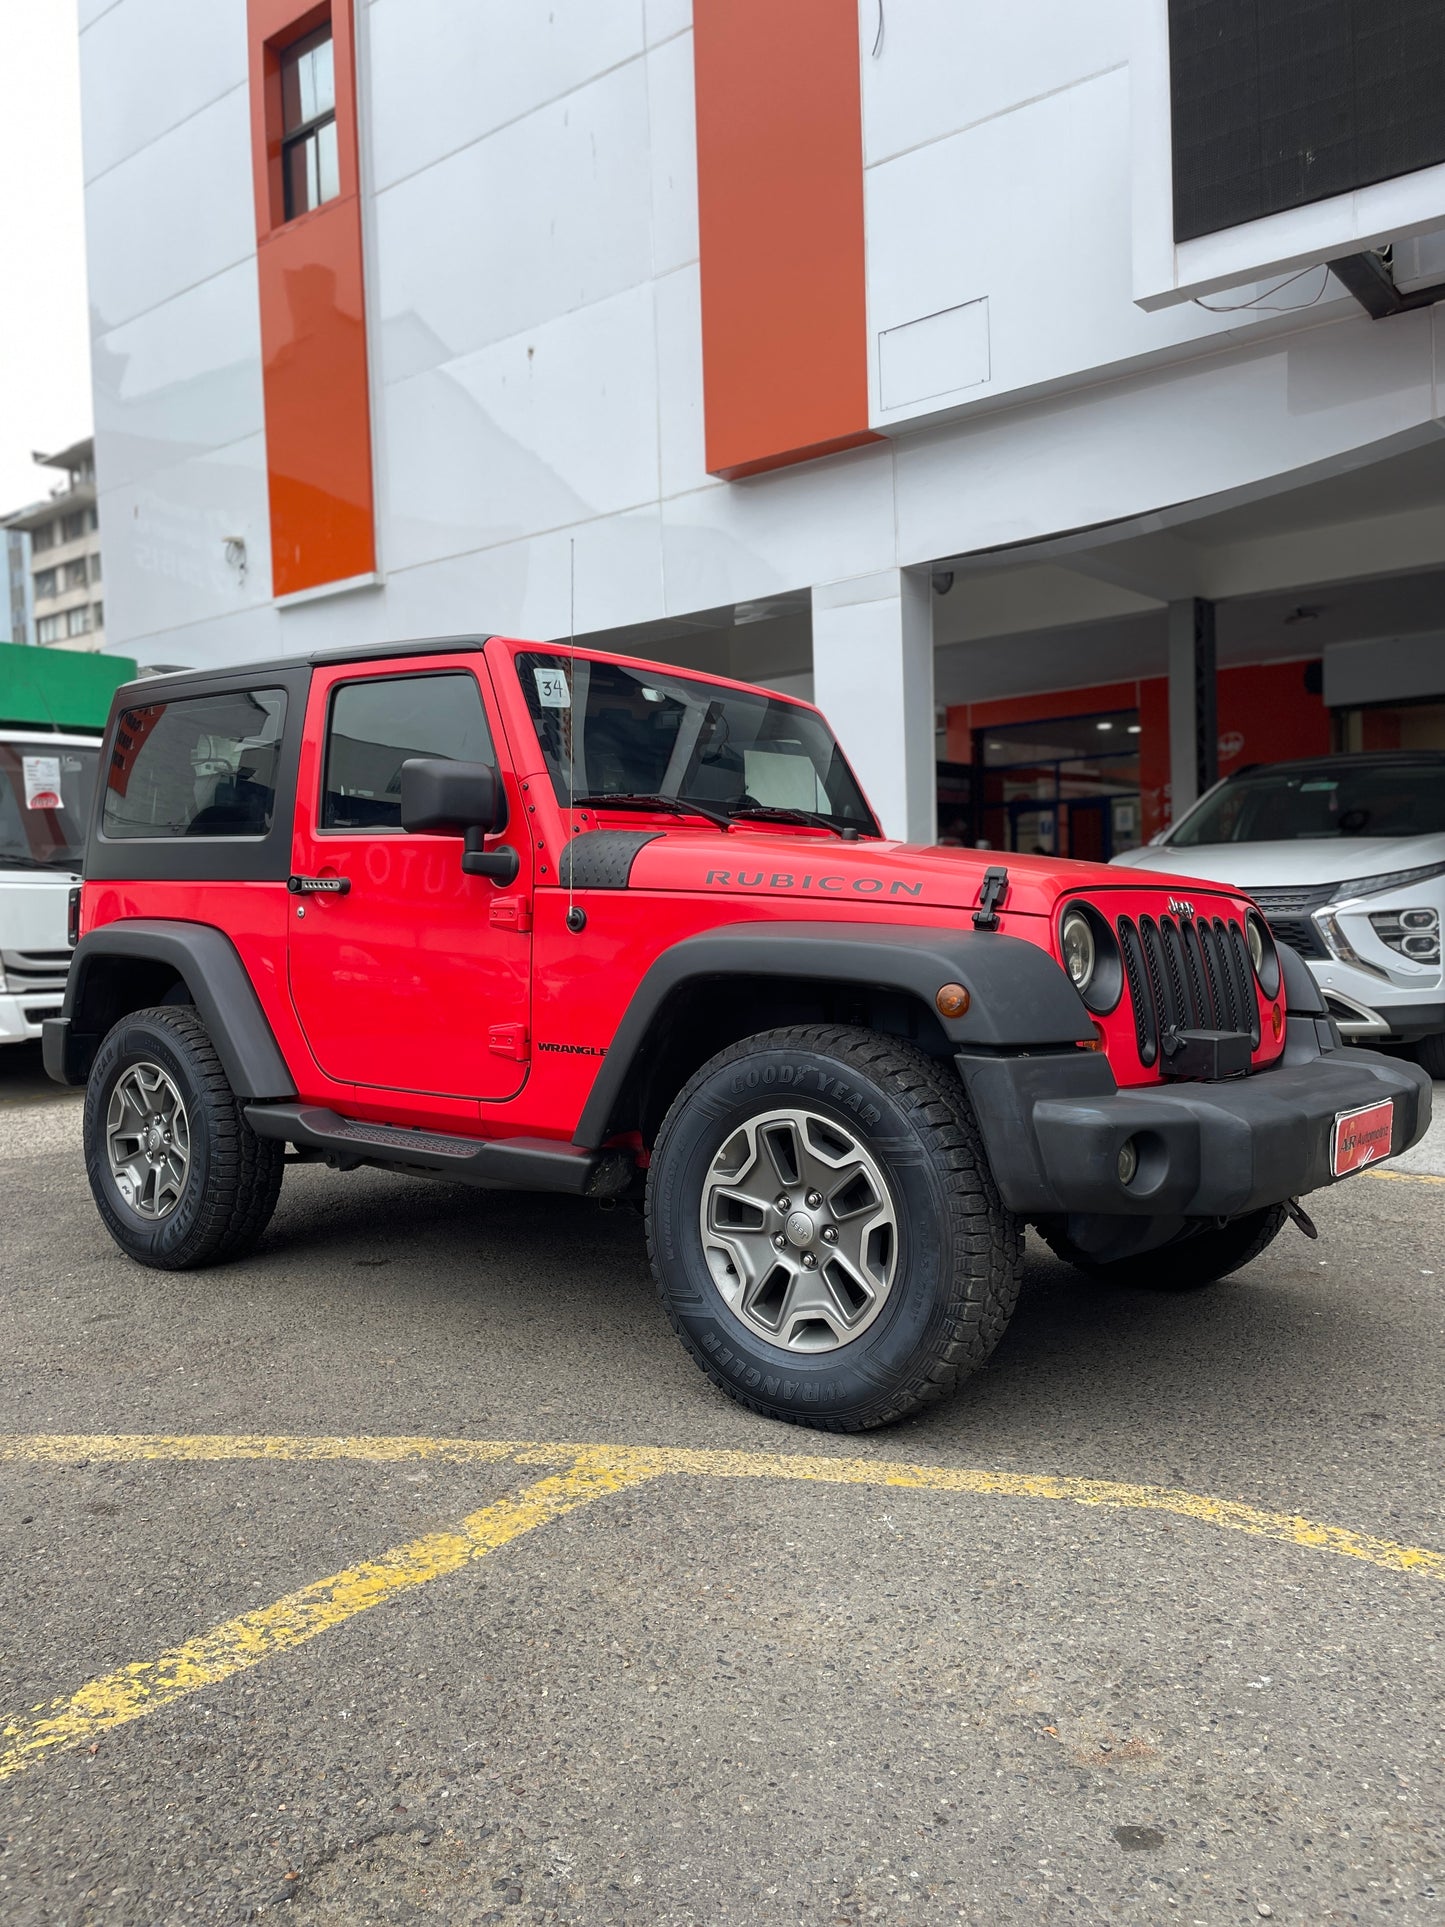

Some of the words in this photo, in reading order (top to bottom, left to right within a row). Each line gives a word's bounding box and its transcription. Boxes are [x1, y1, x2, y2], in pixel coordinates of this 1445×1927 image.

[542, 680, 563, 698] 34
[705, 870, 923, 896] RUBICON
[1168, 896, 1194, 920] Jeep
[790, 1219, 809, 1240] Jeep
[700, 1331, 848, 1402] WRANGLER
